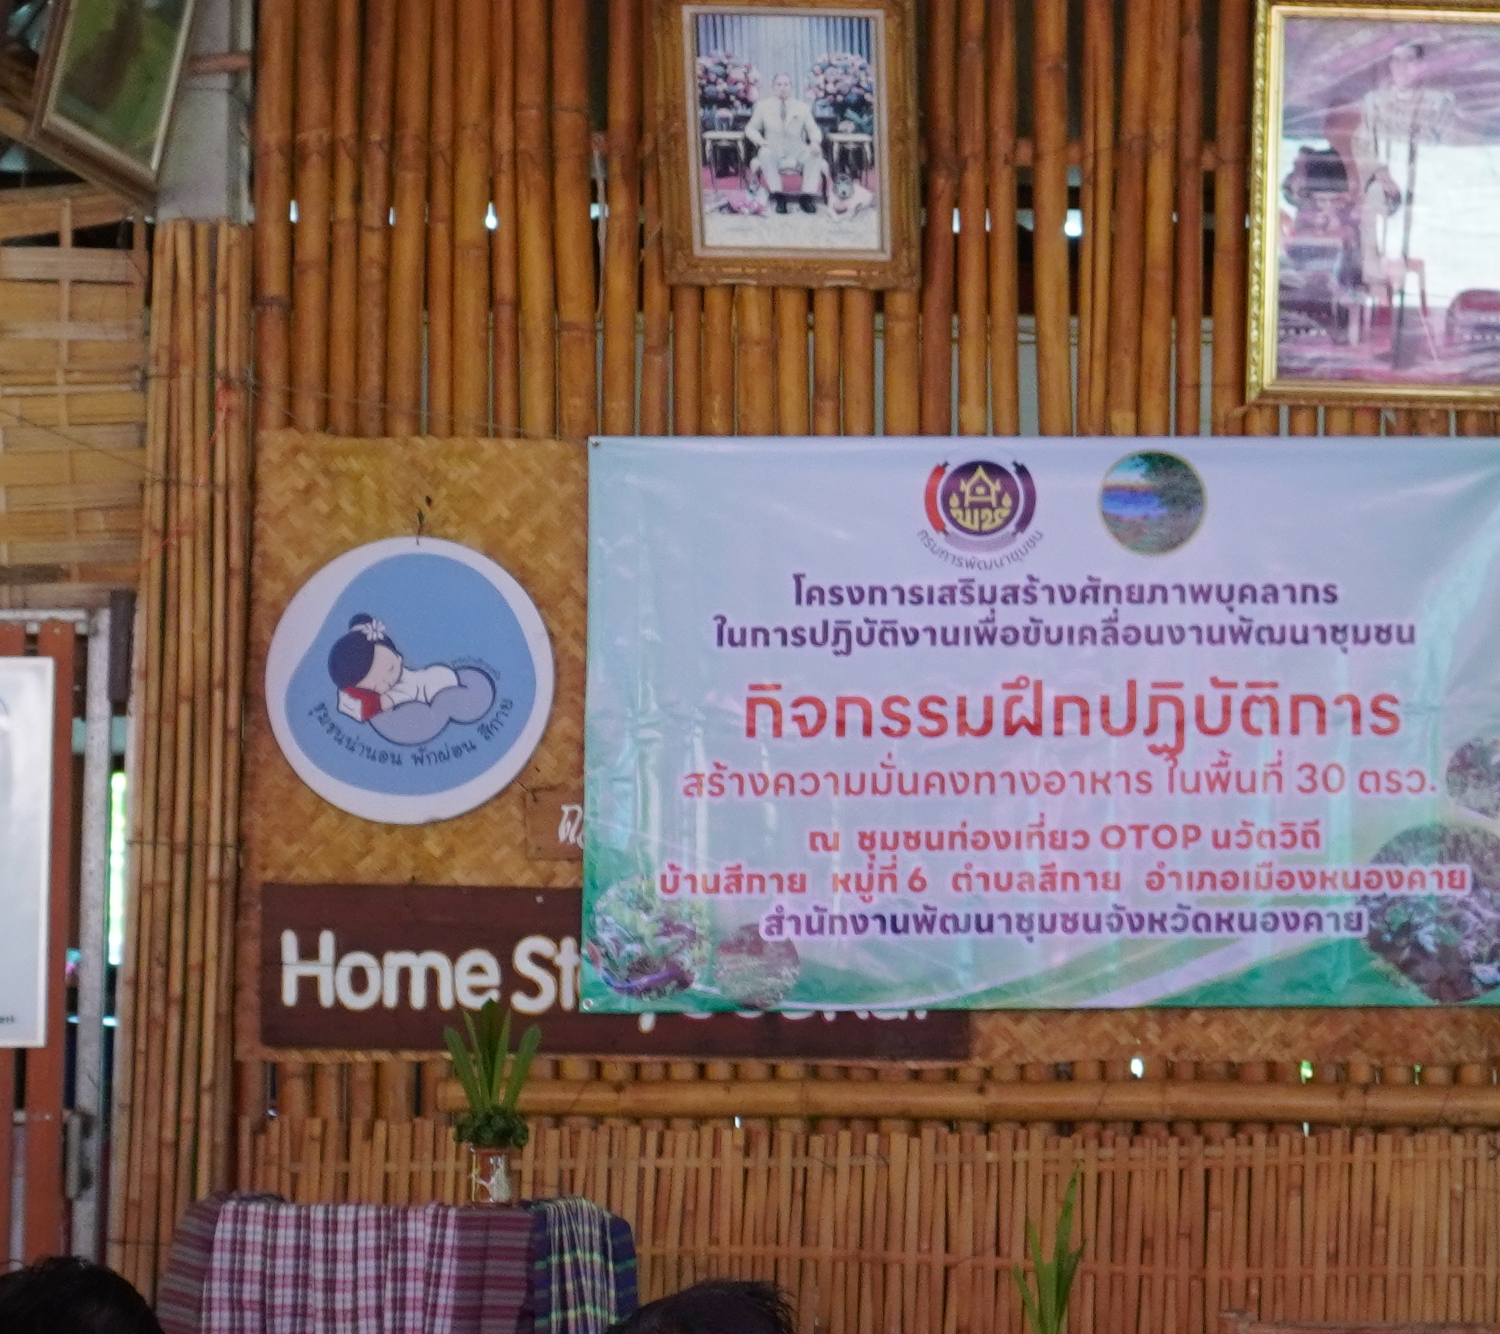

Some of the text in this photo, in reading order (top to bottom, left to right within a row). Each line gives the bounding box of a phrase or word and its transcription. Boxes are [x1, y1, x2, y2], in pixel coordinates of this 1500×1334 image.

[917, 529, 1044, 571] กรมการพัฒนาชุมชน
[792, 572, 1340, 614] โครงการเสริมสร้างศักยภาพบุคลากร
[713, 608, 1416, 656] ในการปฏิบัติงานเพื่อขับเคลื่อนงานพัฒนาชุมชน
[744, 674, 1401, 756] กิจกรรมฝึกปฏิบัติการ
[681, 751, 1437, 798] สร้างความมั่นคงทางอาหาร ในพื้นที่ 30 ตรว.
[808, 812, 1321, 860] ณ ชุมชนท่องเที่ยว OTOP นวัตวิถี
[659, 854, 1468, 904] บ้านสีกาย หมู่ที่ 6 ตำบลสีกาย อำเภอเมืองหนองคาย
[763, 904, 1364, 944] สำนักงานพัฒนาชุมชนจังหวัดหนองคาย
[280, 929, 500, 1012] Home
